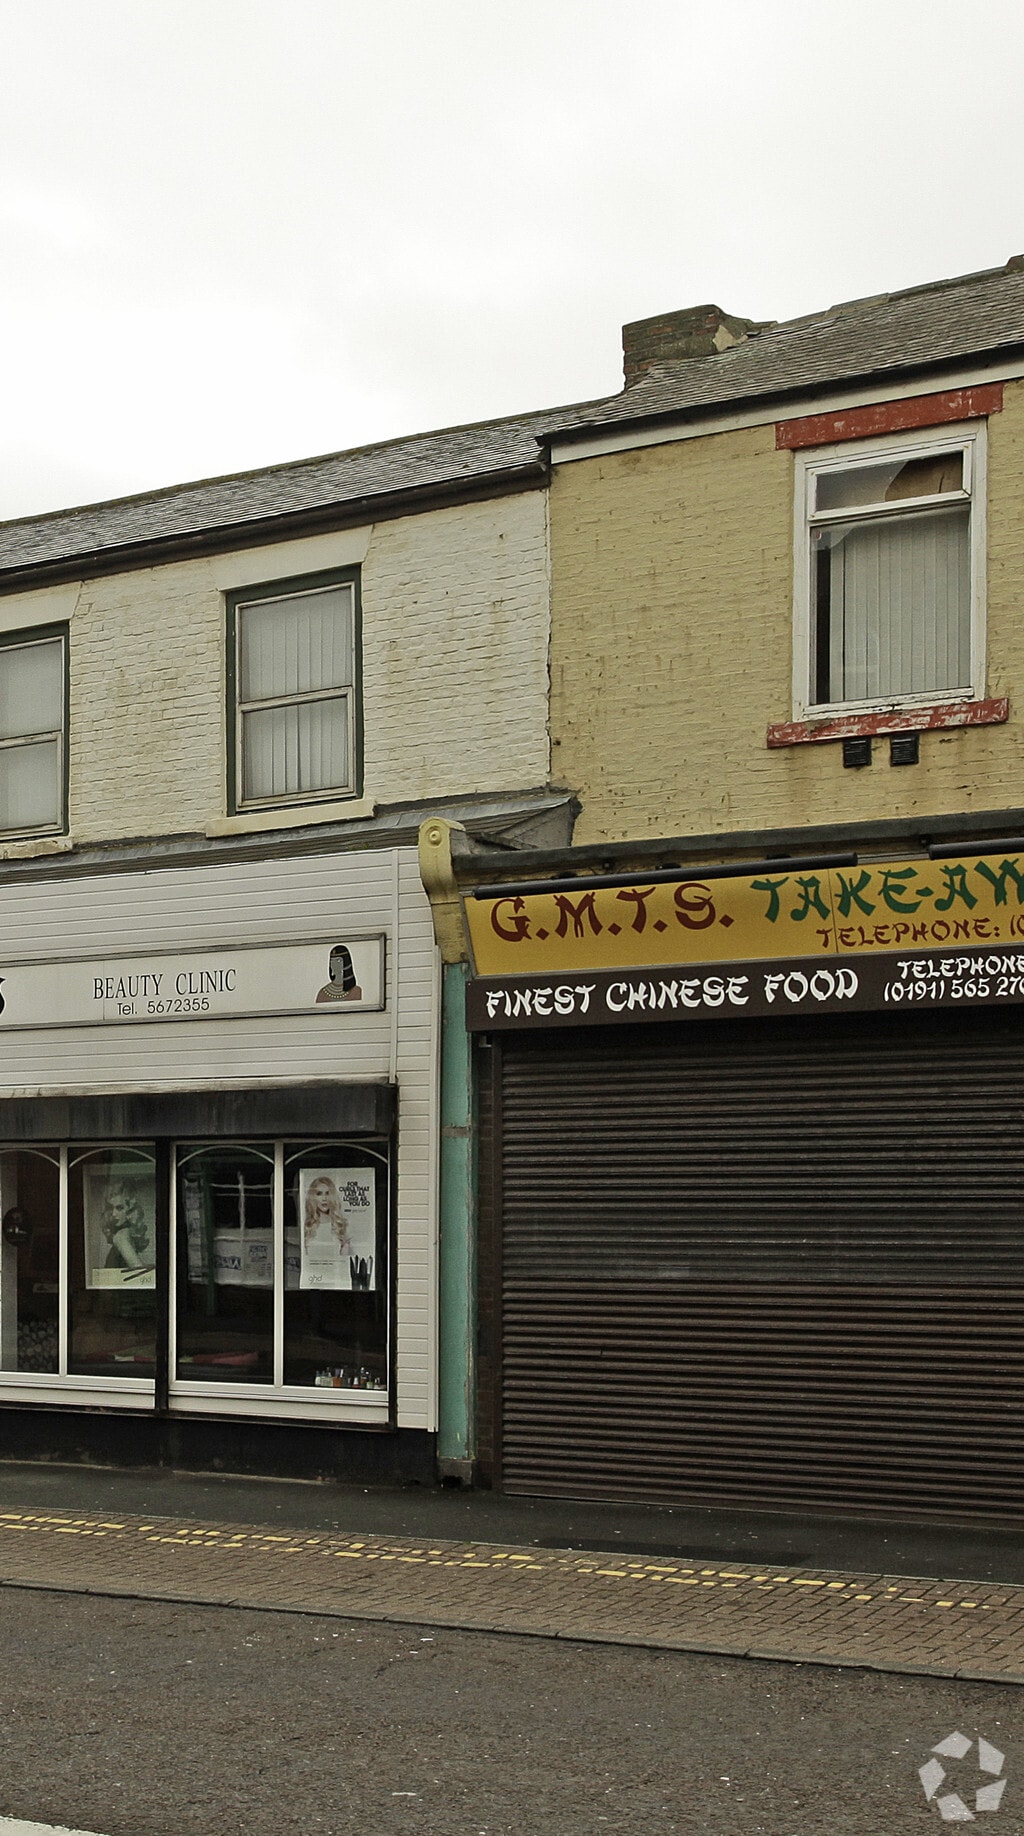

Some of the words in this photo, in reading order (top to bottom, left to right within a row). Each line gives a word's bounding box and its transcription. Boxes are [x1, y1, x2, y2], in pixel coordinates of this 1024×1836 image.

[490, 882, 735, 942] G.M.T.S.
[816, 917, 1000, 948] TELEPHONE:
[93, 974, 164, 999] BEAUTY
[175, 969, 236, 996] CLINIC
[485, 983, 596, 1018] FINEST
[606, 975, 749, 1012] CHINESE
[764, 968, 859, 1003] FOOD
[884, 979, 945, 1002] (0191)
[950, 976, 990, 999] 565
[117, 1002, 137, 1015] Tel.
[147, 997, 210, 1014] 5672355
